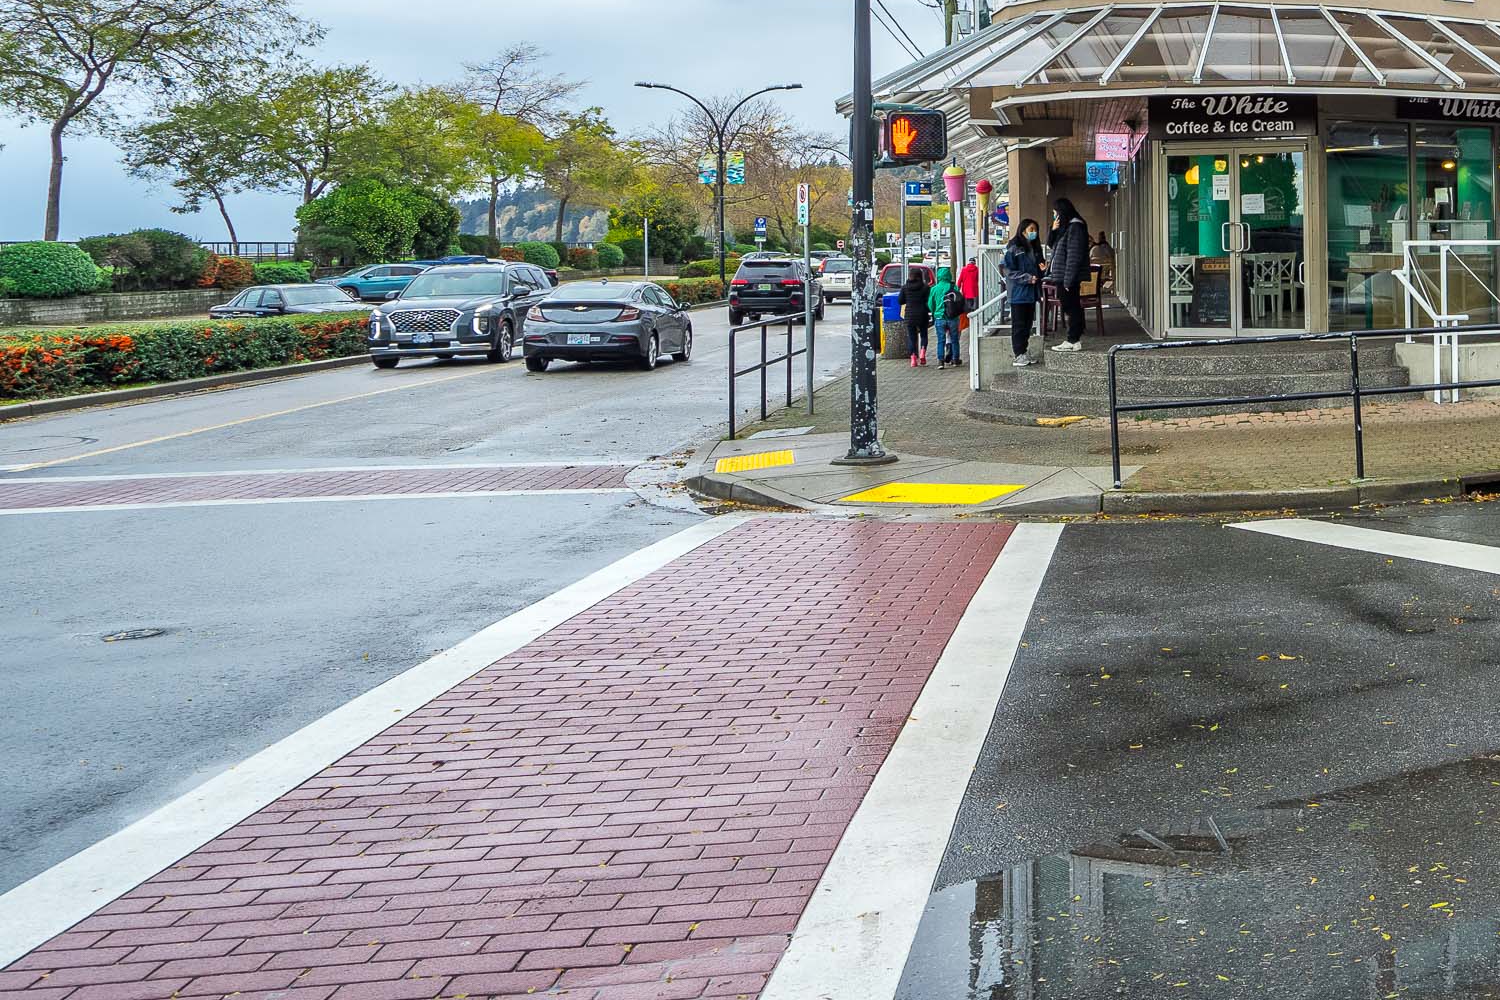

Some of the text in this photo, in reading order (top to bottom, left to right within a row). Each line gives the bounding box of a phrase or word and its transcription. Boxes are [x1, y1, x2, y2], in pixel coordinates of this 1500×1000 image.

[1170, 95, 1289, 116] The White
[1166, 119, 1294, 134] Coffee & Ice Cream
